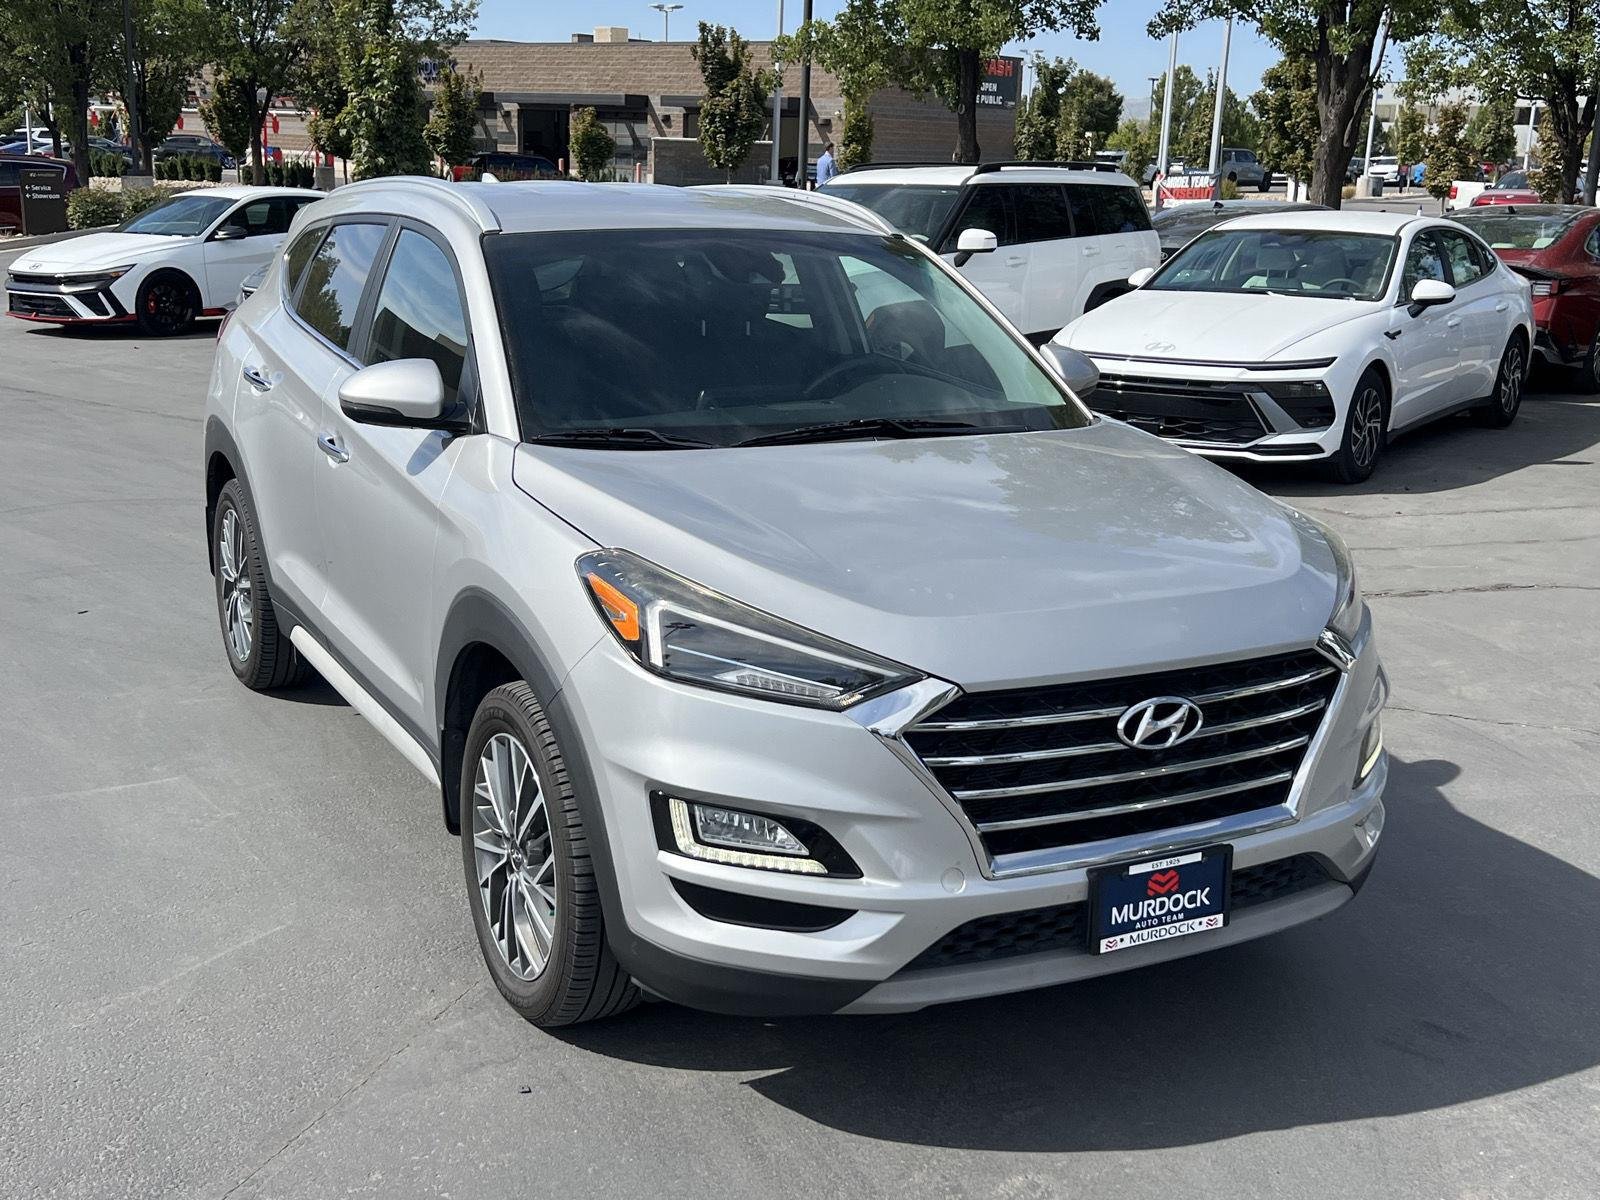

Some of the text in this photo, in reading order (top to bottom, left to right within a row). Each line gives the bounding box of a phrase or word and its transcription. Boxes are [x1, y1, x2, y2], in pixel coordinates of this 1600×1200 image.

[984, 58, 1013, 77] ASH
[980, 95, 1003, 105] PUBLIC
[1191, 176, 1210, 188] YEAR
[1165, 858, 1181, 866] 1925
[1111, 887, 1211, 925] MURDOCK
[1135, 912, 1185, 929] AUTO TEAM
[1129, 921, 1196, 945] MURDOCK
